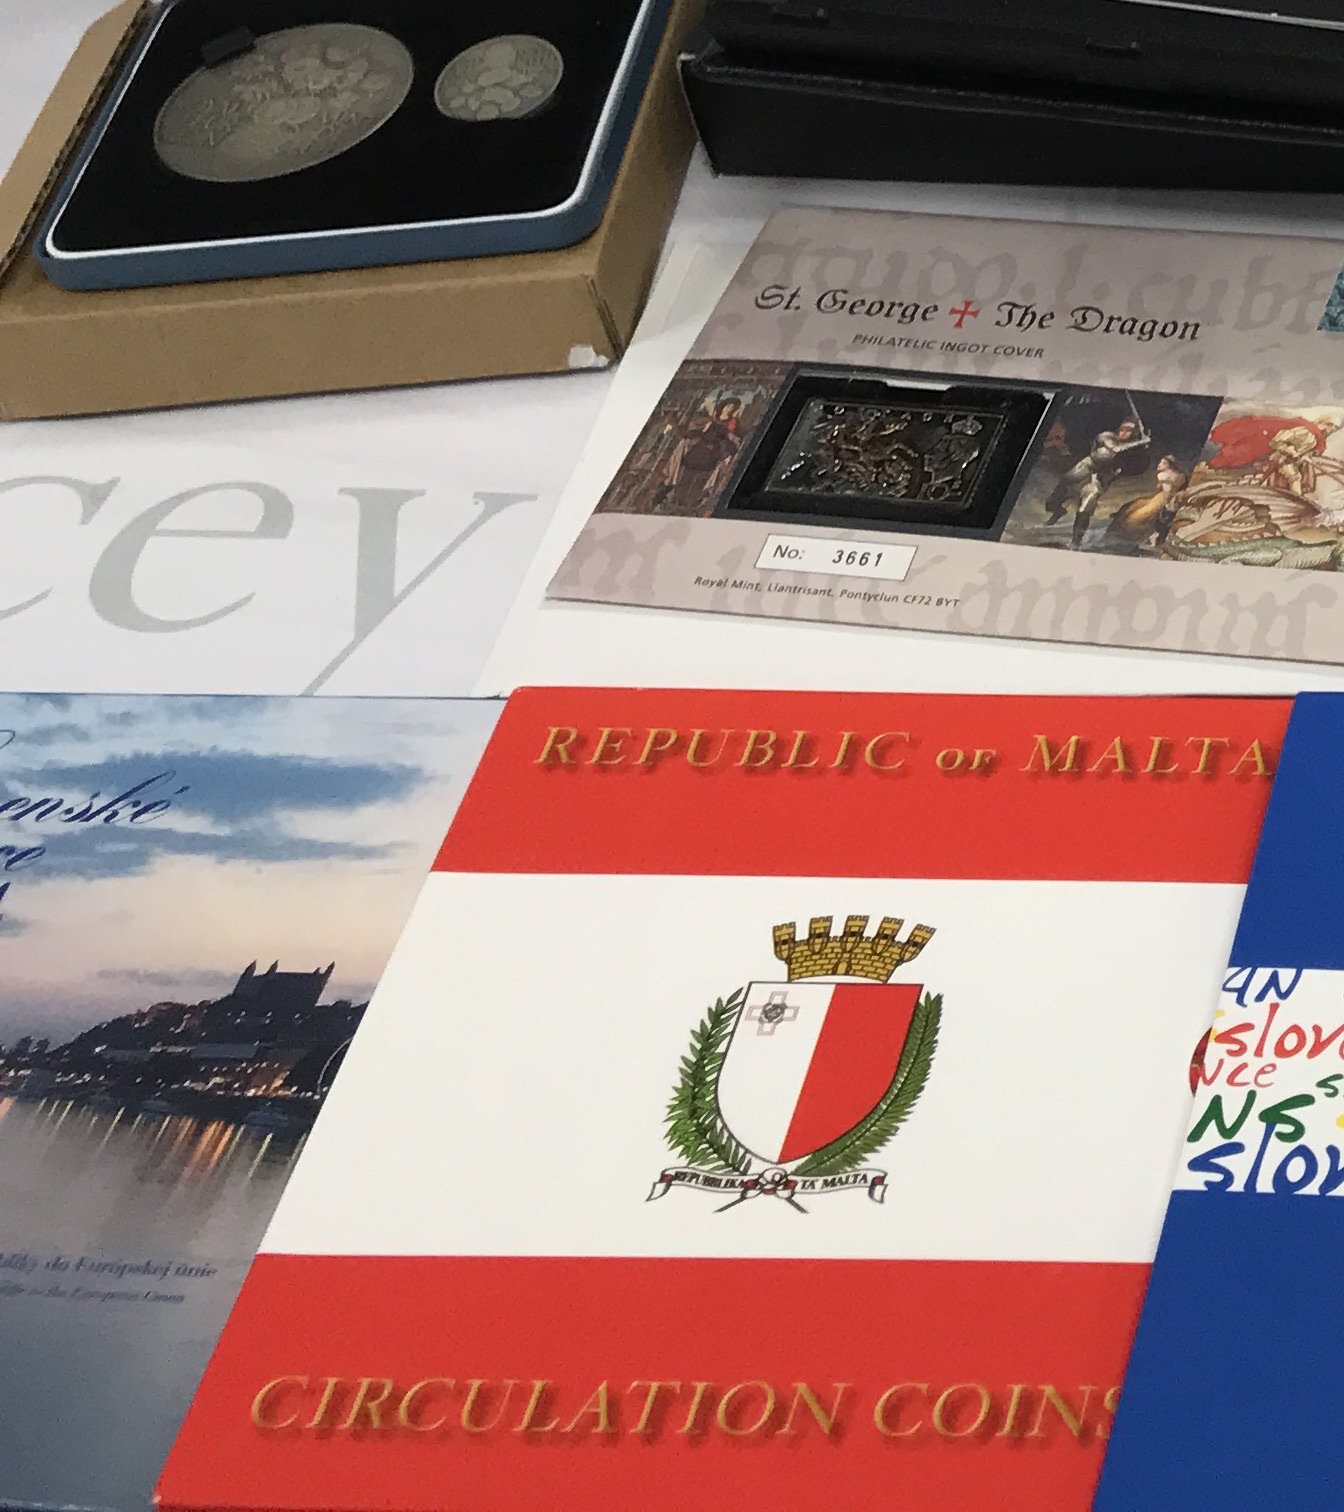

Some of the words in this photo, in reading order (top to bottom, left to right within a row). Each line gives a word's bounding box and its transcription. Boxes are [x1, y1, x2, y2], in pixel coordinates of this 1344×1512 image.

[754, 284, 802, 312] St.
[815, 287, 940, 325] George
[994, 301, 1056, 333] The
[1066, 304, 1202, 343] Dragon
[852, 333, 936, 352] PHILATELIC
[939, 340, 990, 356] INGOT
[993, 345, 1045, 359] COVER
[831, 550, 884, 569] 3661
[694, 575, 728, 590] Royal
[839, 586, 899, 605] Pontyclun
[903, 593, 932, 607] CF72
[533, 724, 911, 774] REPUBLIC
[1021, 734, 1275, 778] MALTA
[821, 1173, 868, 1190] MALTA
[249, 1374, 857, 1439] CIRCULATION
